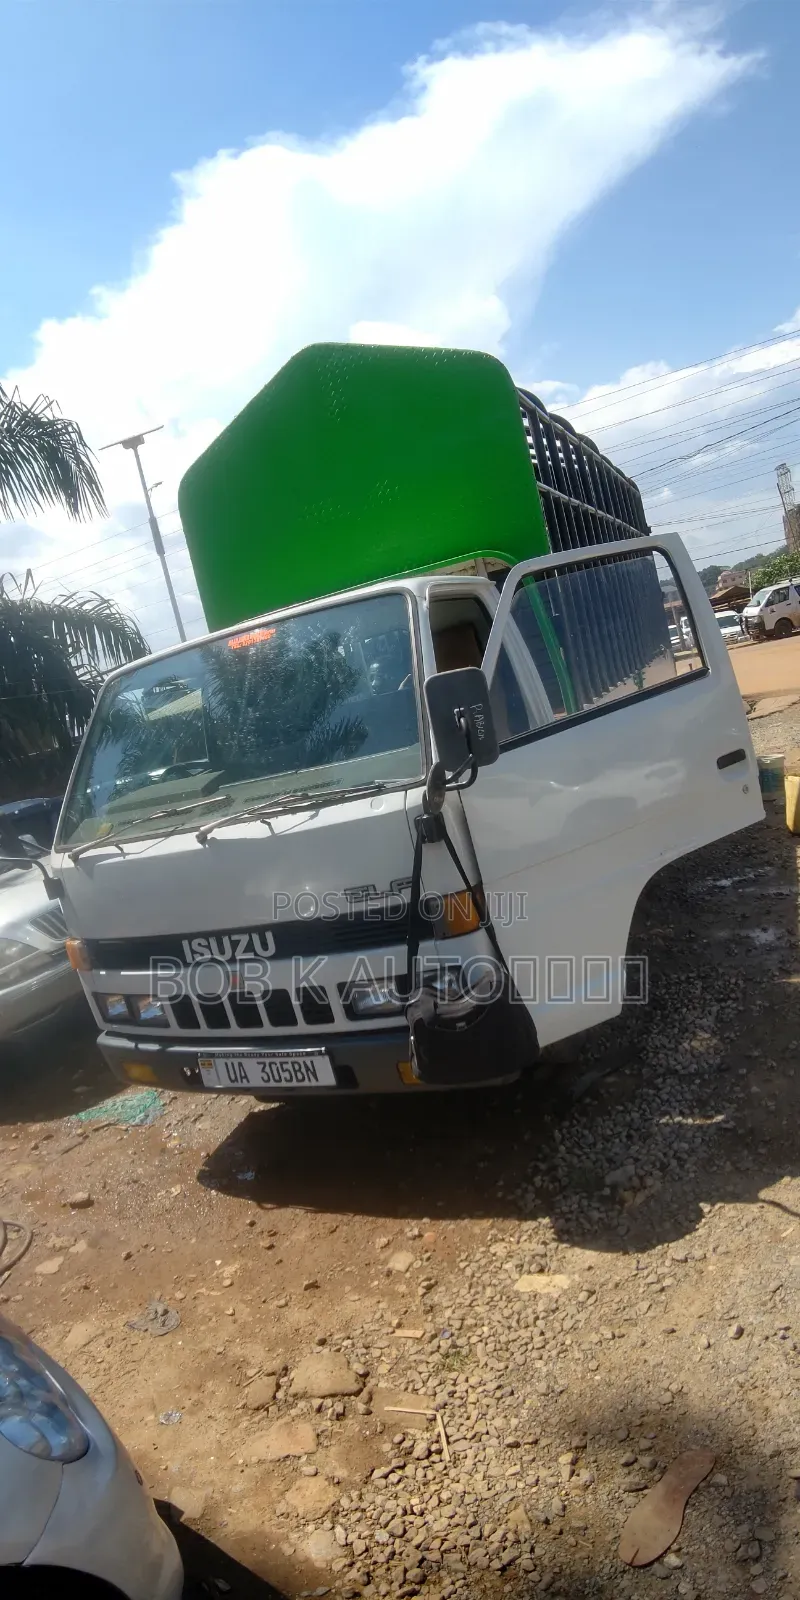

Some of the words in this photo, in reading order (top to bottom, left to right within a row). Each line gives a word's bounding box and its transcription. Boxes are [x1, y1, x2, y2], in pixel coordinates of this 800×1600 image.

[181, 930, 276, 964] ISUZU
[224, 1061, 250, 1084] UA
[257, 1060, 319, 1084] 305BN
